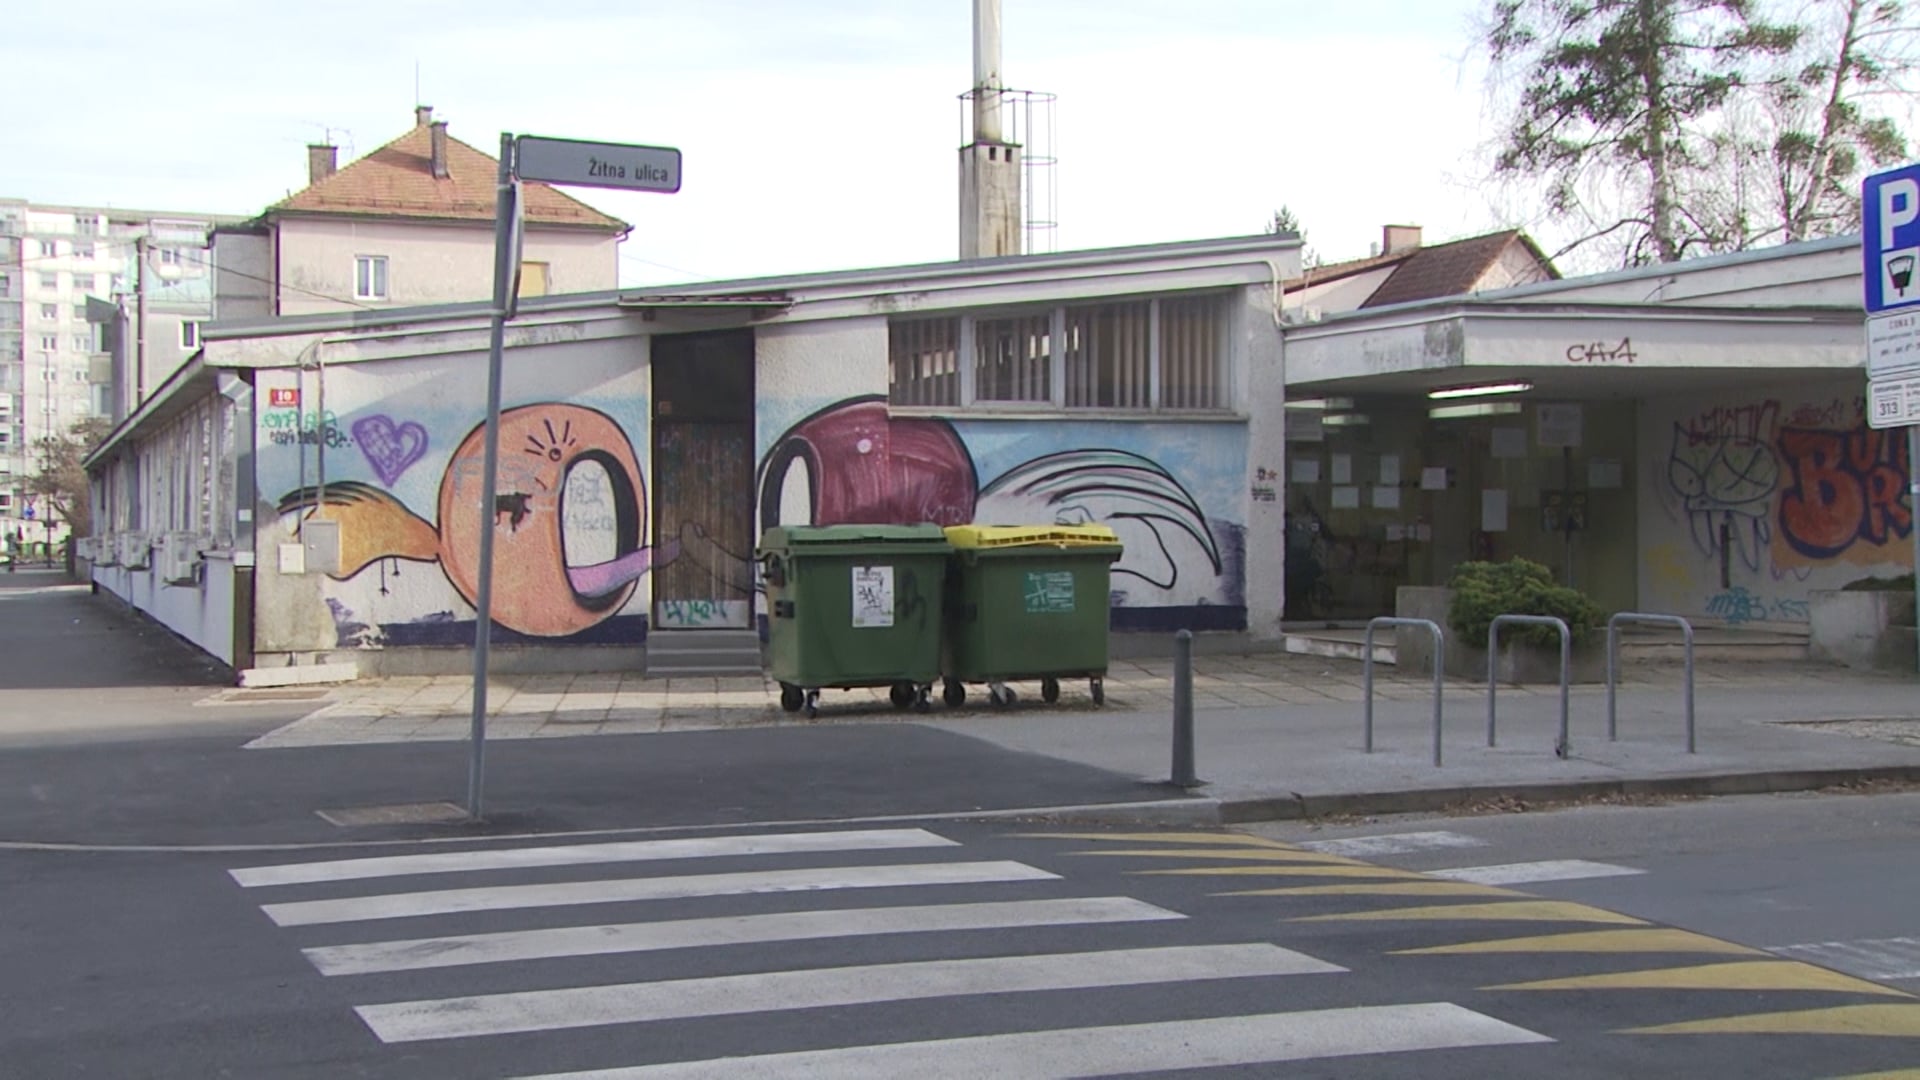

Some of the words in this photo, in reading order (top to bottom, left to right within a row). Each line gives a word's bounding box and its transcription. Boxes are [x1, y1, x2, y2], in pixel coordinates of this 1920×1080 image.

[588, 157, 626, 179] Žitna
[634, 163, 669, 182] ulica
[1879, 178, 1919, 250] P
[1880, 401, 1899, 416] 313
